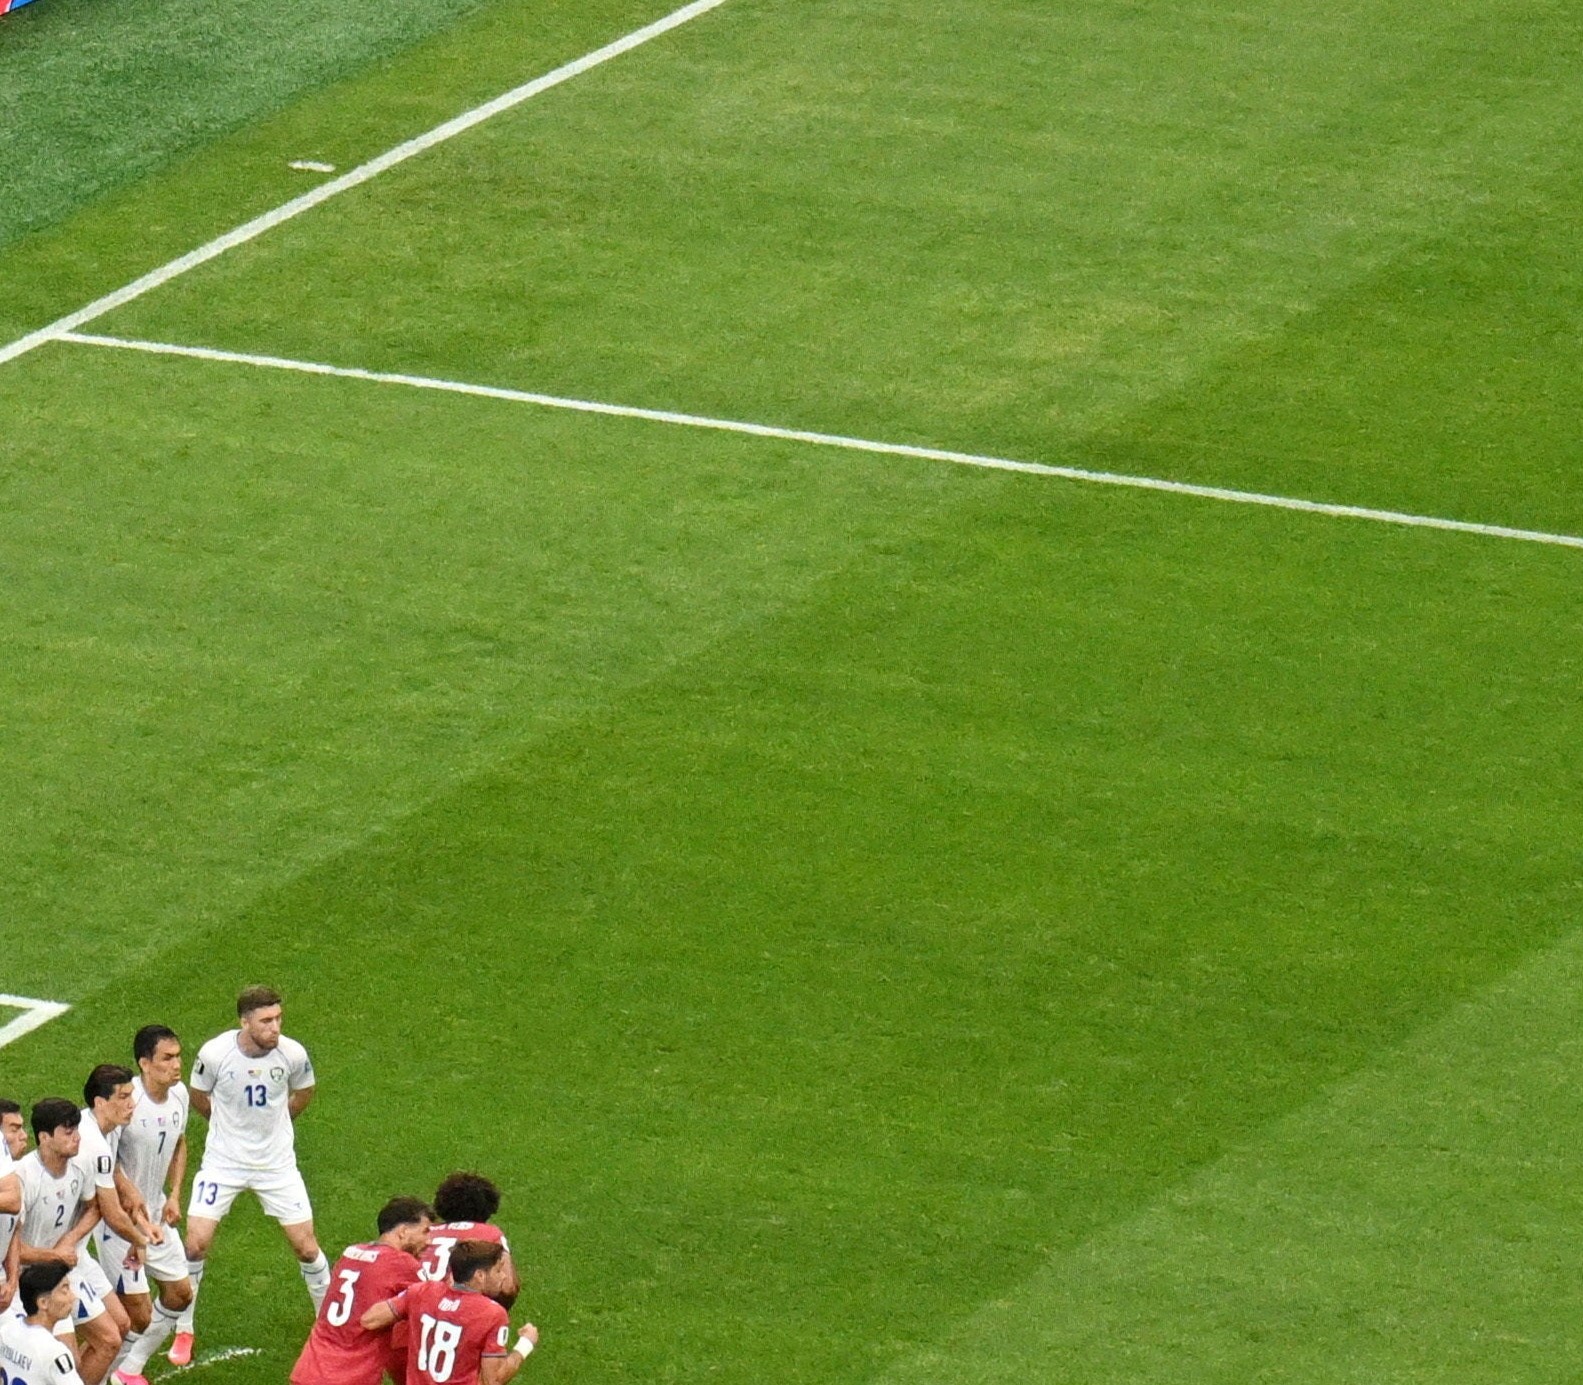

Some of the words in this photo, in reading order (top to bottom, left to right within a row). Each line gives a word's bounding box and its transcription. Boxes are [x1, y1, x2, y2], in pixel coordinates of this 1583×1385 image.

[244, 1084, 267, 1107] 13
[158, 1131, 167, 1154] 7
[197, 1179, 218, 1206] 13
[53, 1204, 64, 1228] 2
[419, 1236, 457, 1283] 3
[325, 1268, 360, 1327] 3
[418, 1313, 462, 1383] 18
